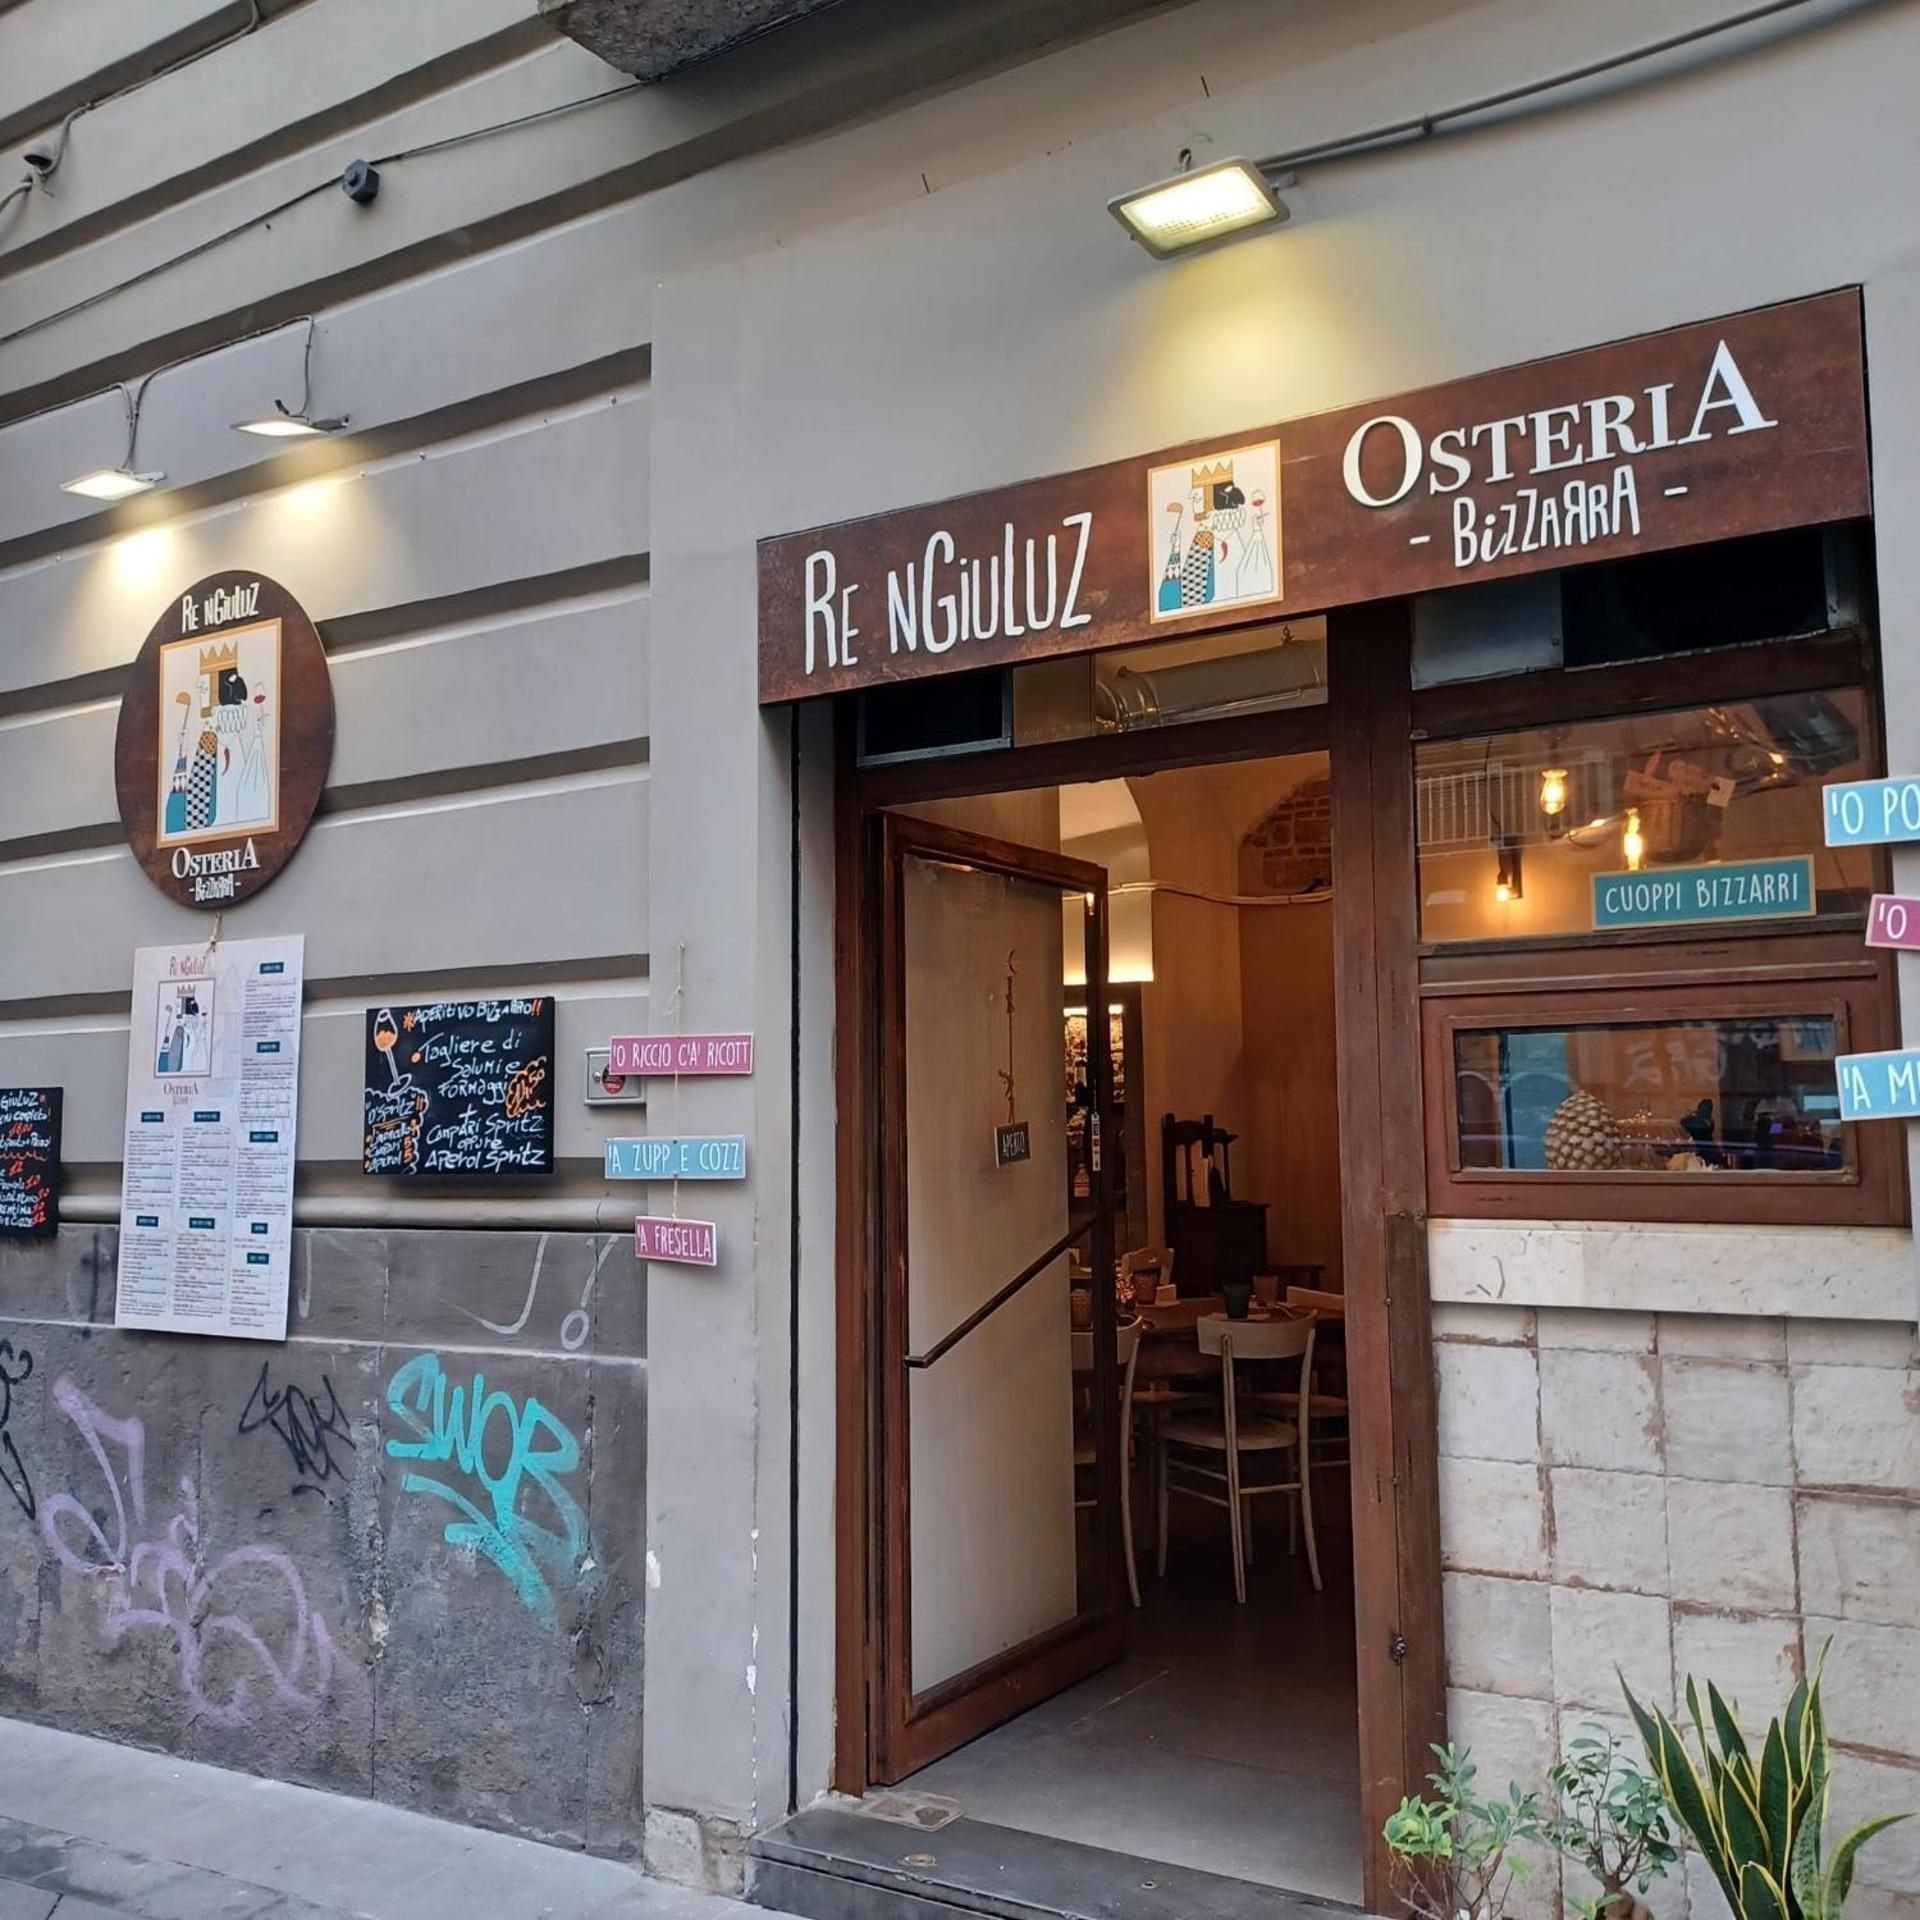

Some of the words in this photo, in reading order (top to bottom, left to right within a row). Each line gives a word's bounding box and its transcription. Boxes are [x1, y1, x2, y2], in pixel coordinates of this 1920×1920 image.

[1343, 339, 1778, 507] OSTERIA
[172, 837, 260, 879] OSTERIA
[1605, 882, 1681, 913] CUOPPI
[1695, 872, 1799, 908] BIZZARRI
[502, 1028, 522, 1050] di
[632, 1042, 672, 1068] RICCIO
[707, 1042, 749, 1067] RICOTT
[1887, 1060, 1920, 1106] M
[632, 1144, 671, 1173] ZUPP
[680, 1145, 689, 1172] E
[699, 1143, 741, 1171] COZZ
[655, 1225, 712, 1259] FRESELLA
